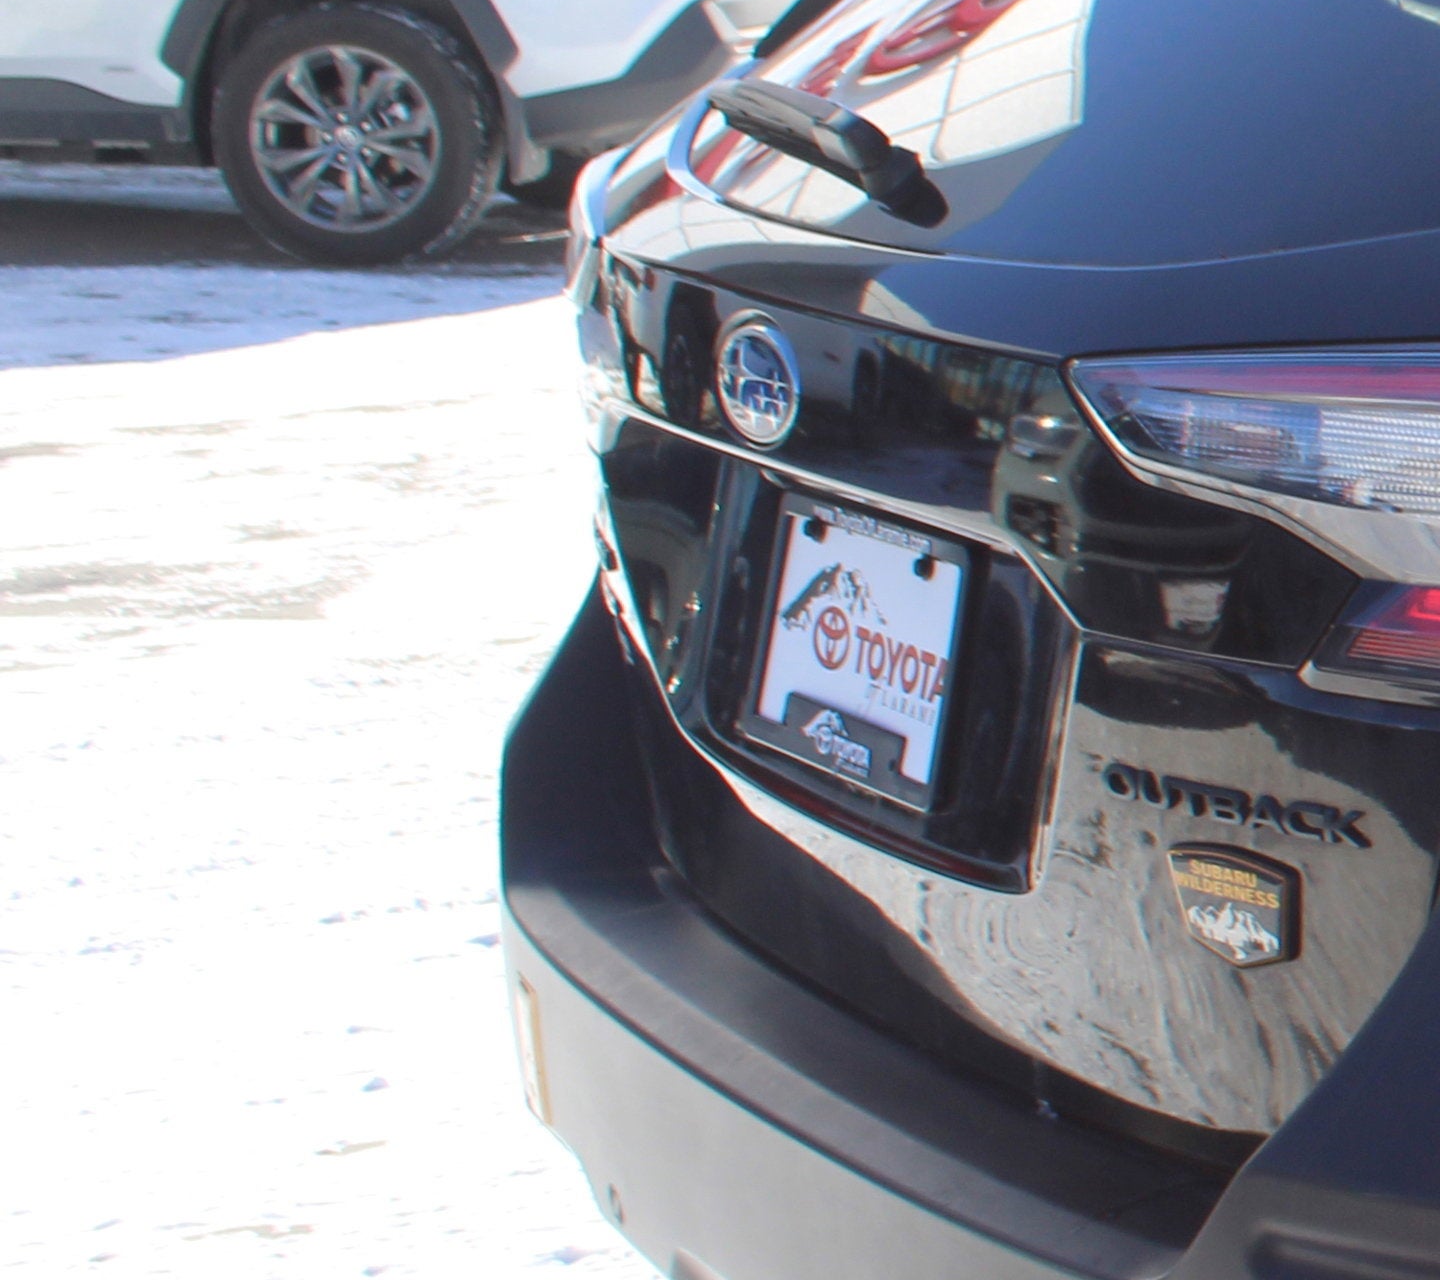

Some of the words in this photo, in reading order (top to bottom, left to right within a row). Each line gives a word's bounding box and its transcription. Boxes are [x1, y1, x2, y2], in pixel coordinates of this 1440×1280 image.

[855, 625, 949, 703] TOYOTA
[1103, 763, 1373, 848] OUTBACK
[1175, 871, 1281, 909] WILDERNESS
[1189, 859, 1258, 888] SUBARU
